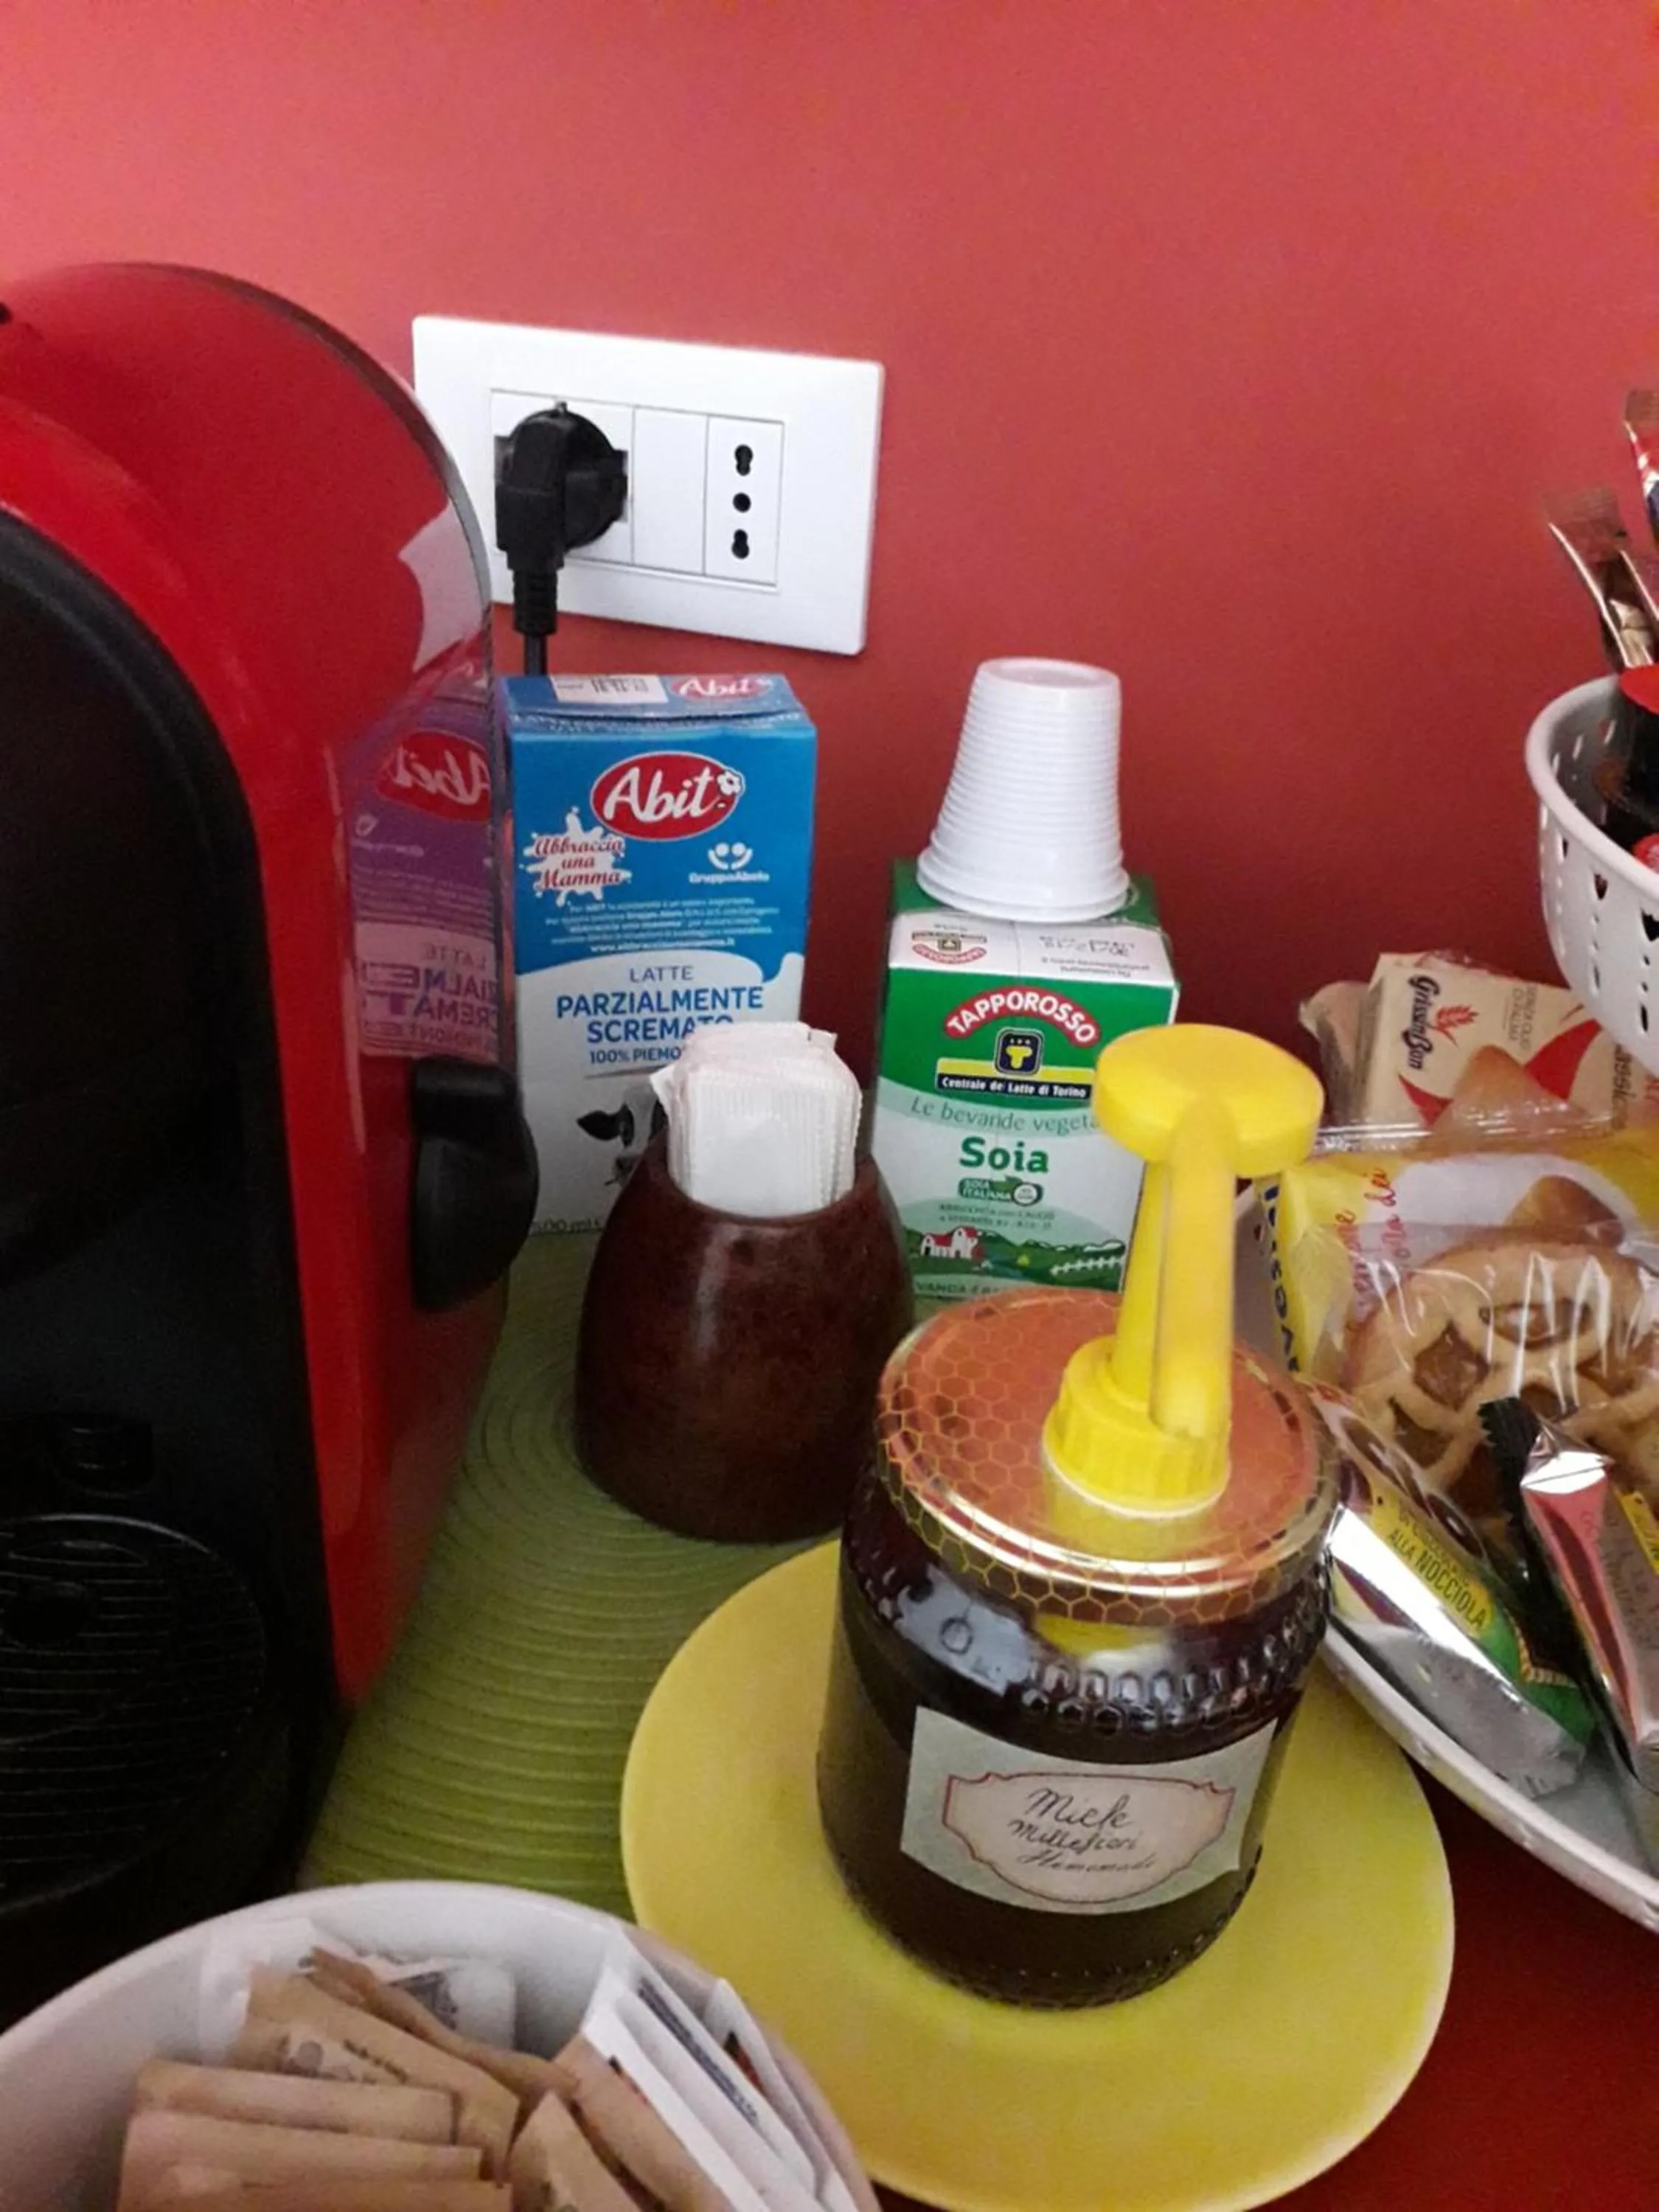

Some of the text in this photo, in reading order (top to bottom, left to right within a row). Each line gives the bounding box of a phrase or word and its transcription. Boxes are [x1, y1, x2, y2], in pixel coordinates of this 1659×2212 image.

[678, 678, 750, 696] Abit
[604, 767, 720, 823] Abit
[535, 837, 622, 855] Abbraccia
[562, 857, 595, 869] una
[543, 869, 620, 888] Mamma
[630, 965, 694, 983] LATTE
[557, 987, 763, 1018] PARZIALMENTE
[588, 1015, 733, 1043] SCREMA
[947, 991, 1096, 1043] TAPPOROSSO
[590, 1046, 685, 1064] 100% PIEMO
[942, 1077, 986, 1091] Centrale
[1008, 1082, 1034, 1094] Latte
[1038, 1084, 1049, 1095] di
[1053, 1085, 1086, 1097] Torino
[911, 1096, 934, 1116] Le
[942, 1102, 1025, 1131] bevande
[959, 1136, 1048, 1173] Soia
[1387, 1528, 1487, 1630] ALLA NOCCIOLA
